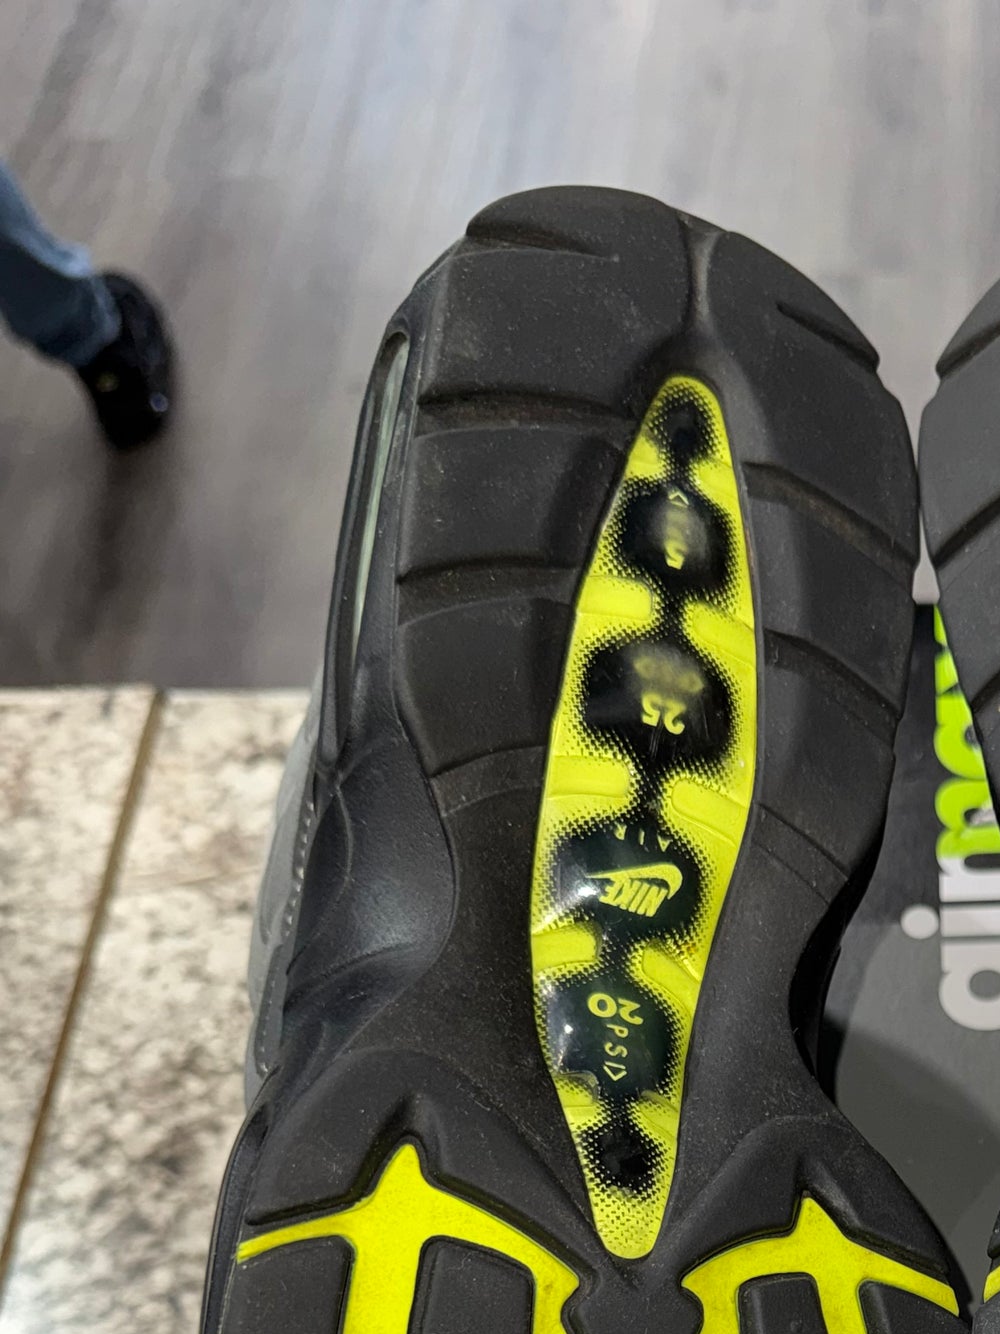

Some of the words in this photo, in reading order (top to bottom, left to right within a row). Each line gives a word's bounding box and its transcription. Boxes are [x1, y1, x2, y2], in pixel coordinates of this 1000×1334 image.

[639, 691, 687, 735] 25
[613, 824, 674, 852] AIR
[599, 875, 669, 918] NIKE
[587, 992, 645, 1026] 20
[603, 1023, 630, 1070] PSI
